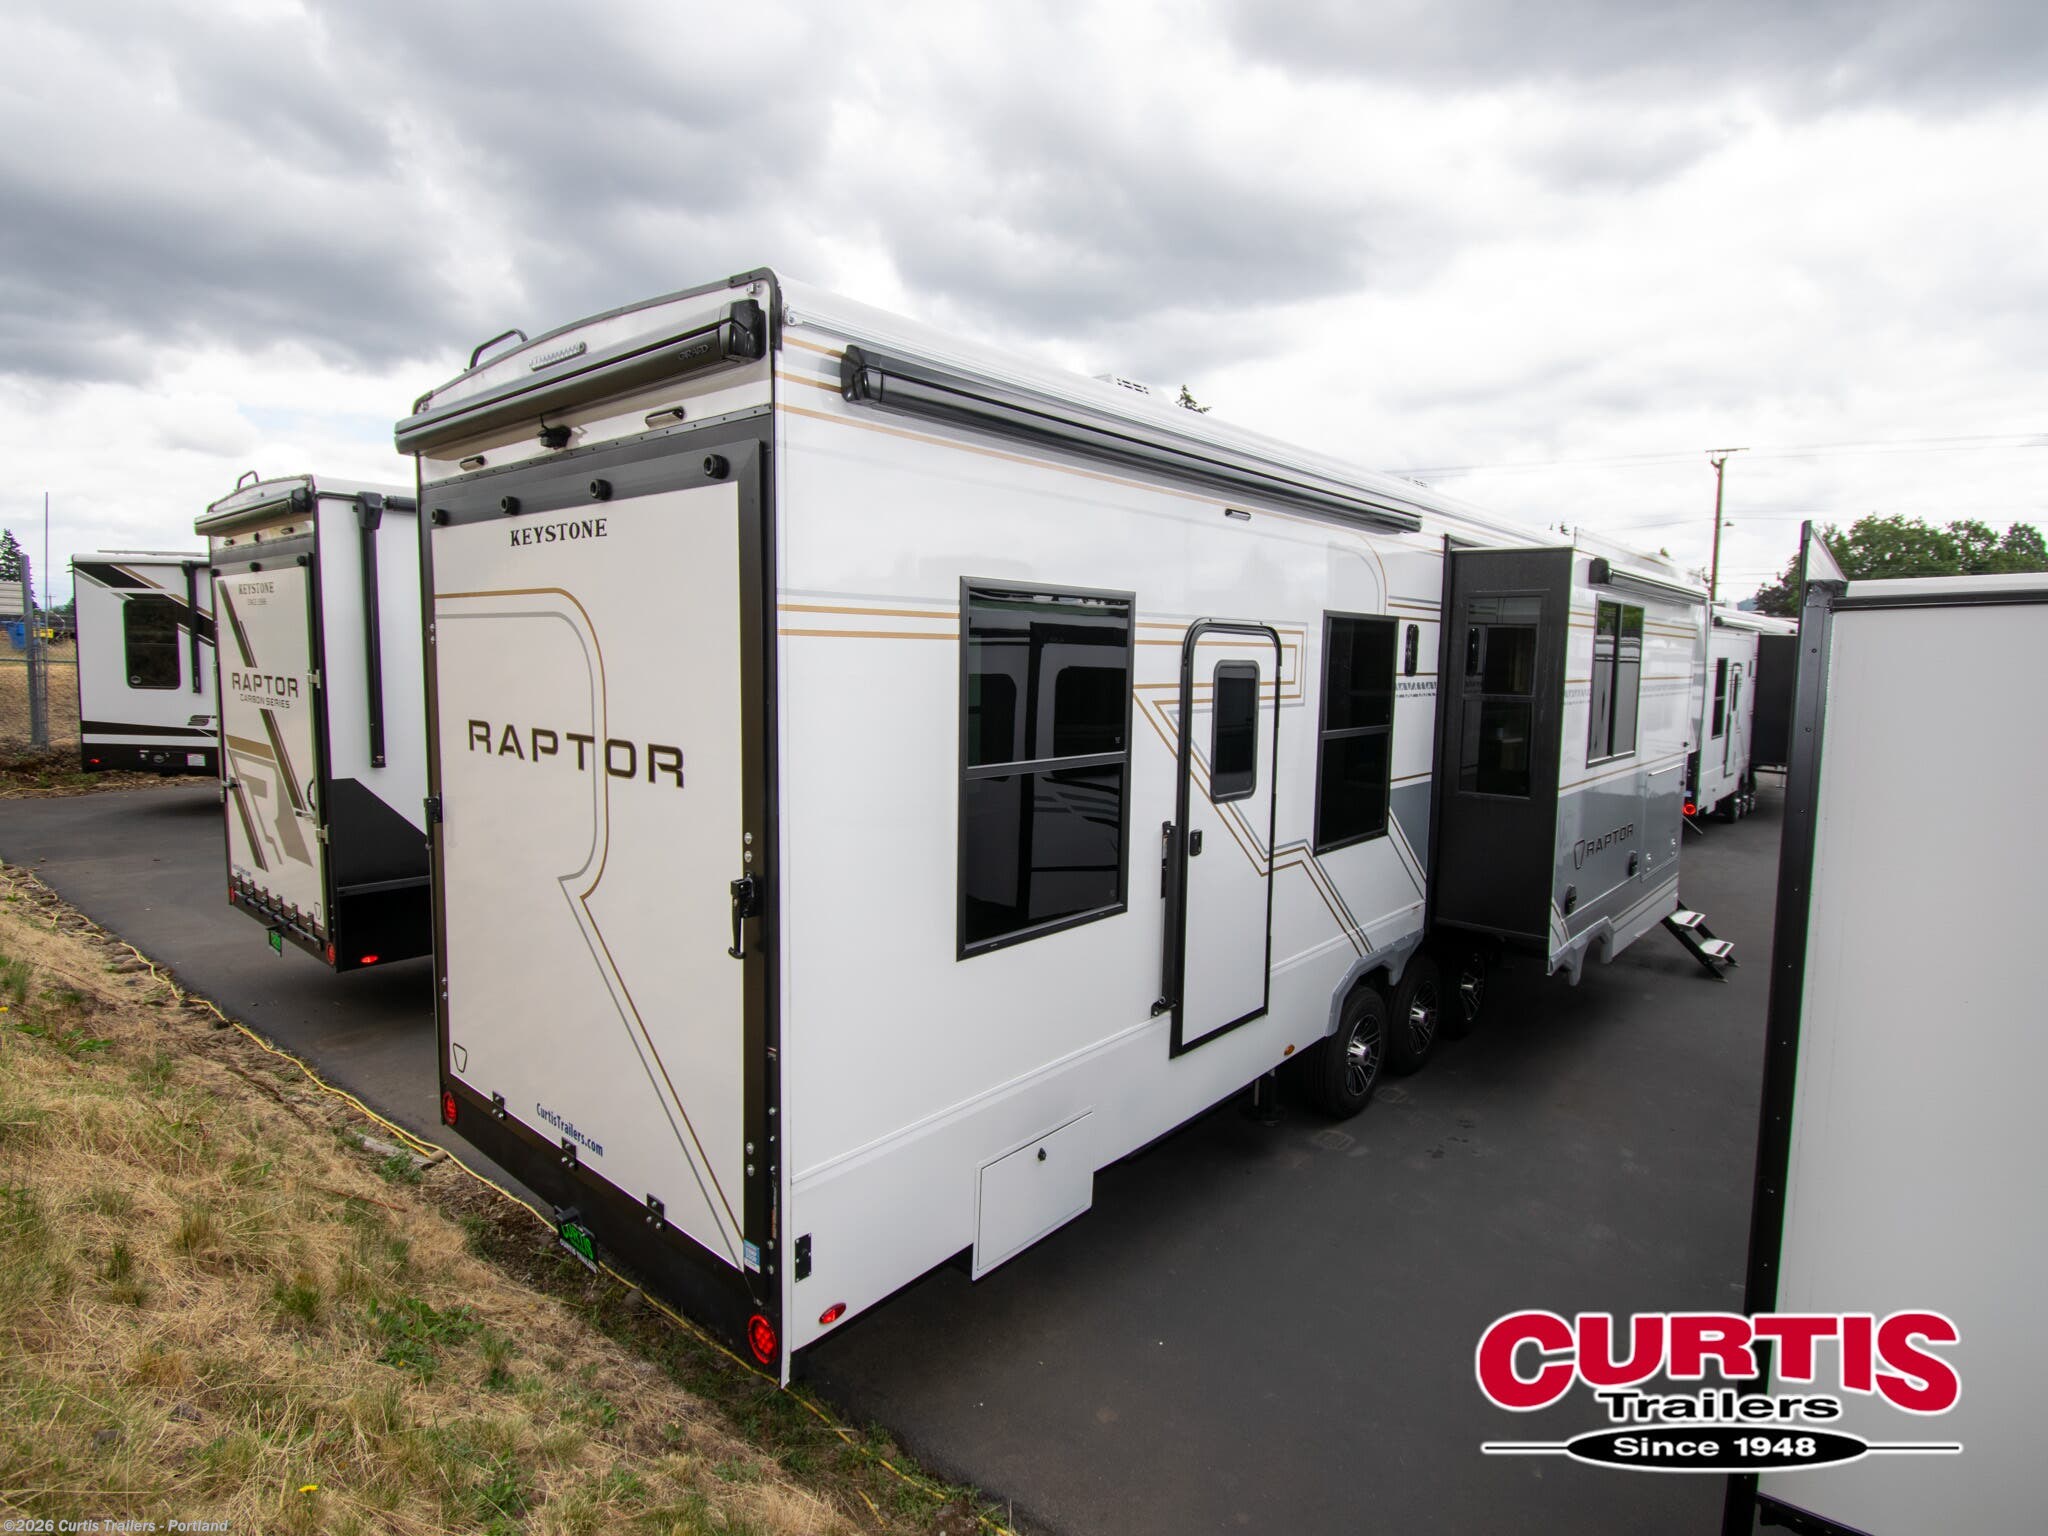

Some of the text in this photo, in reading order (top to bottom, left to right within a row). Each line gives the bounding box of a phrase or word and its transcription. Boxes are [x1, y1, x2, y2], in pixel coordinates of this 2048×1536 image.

[510, 518, 608, 547] KEYSTONE
[238, 581, 275, 595] KEYSTONE
[231, 672, 299, 698] RAPTOR
[239, 693, 291, 709] CARBON SERIES
[468, 719, 685, 789] RAPTOR
[1586, 823, 1634, 857] RAPTOR
[536, 1102, 604, 1157] CurtisTrailers.com
